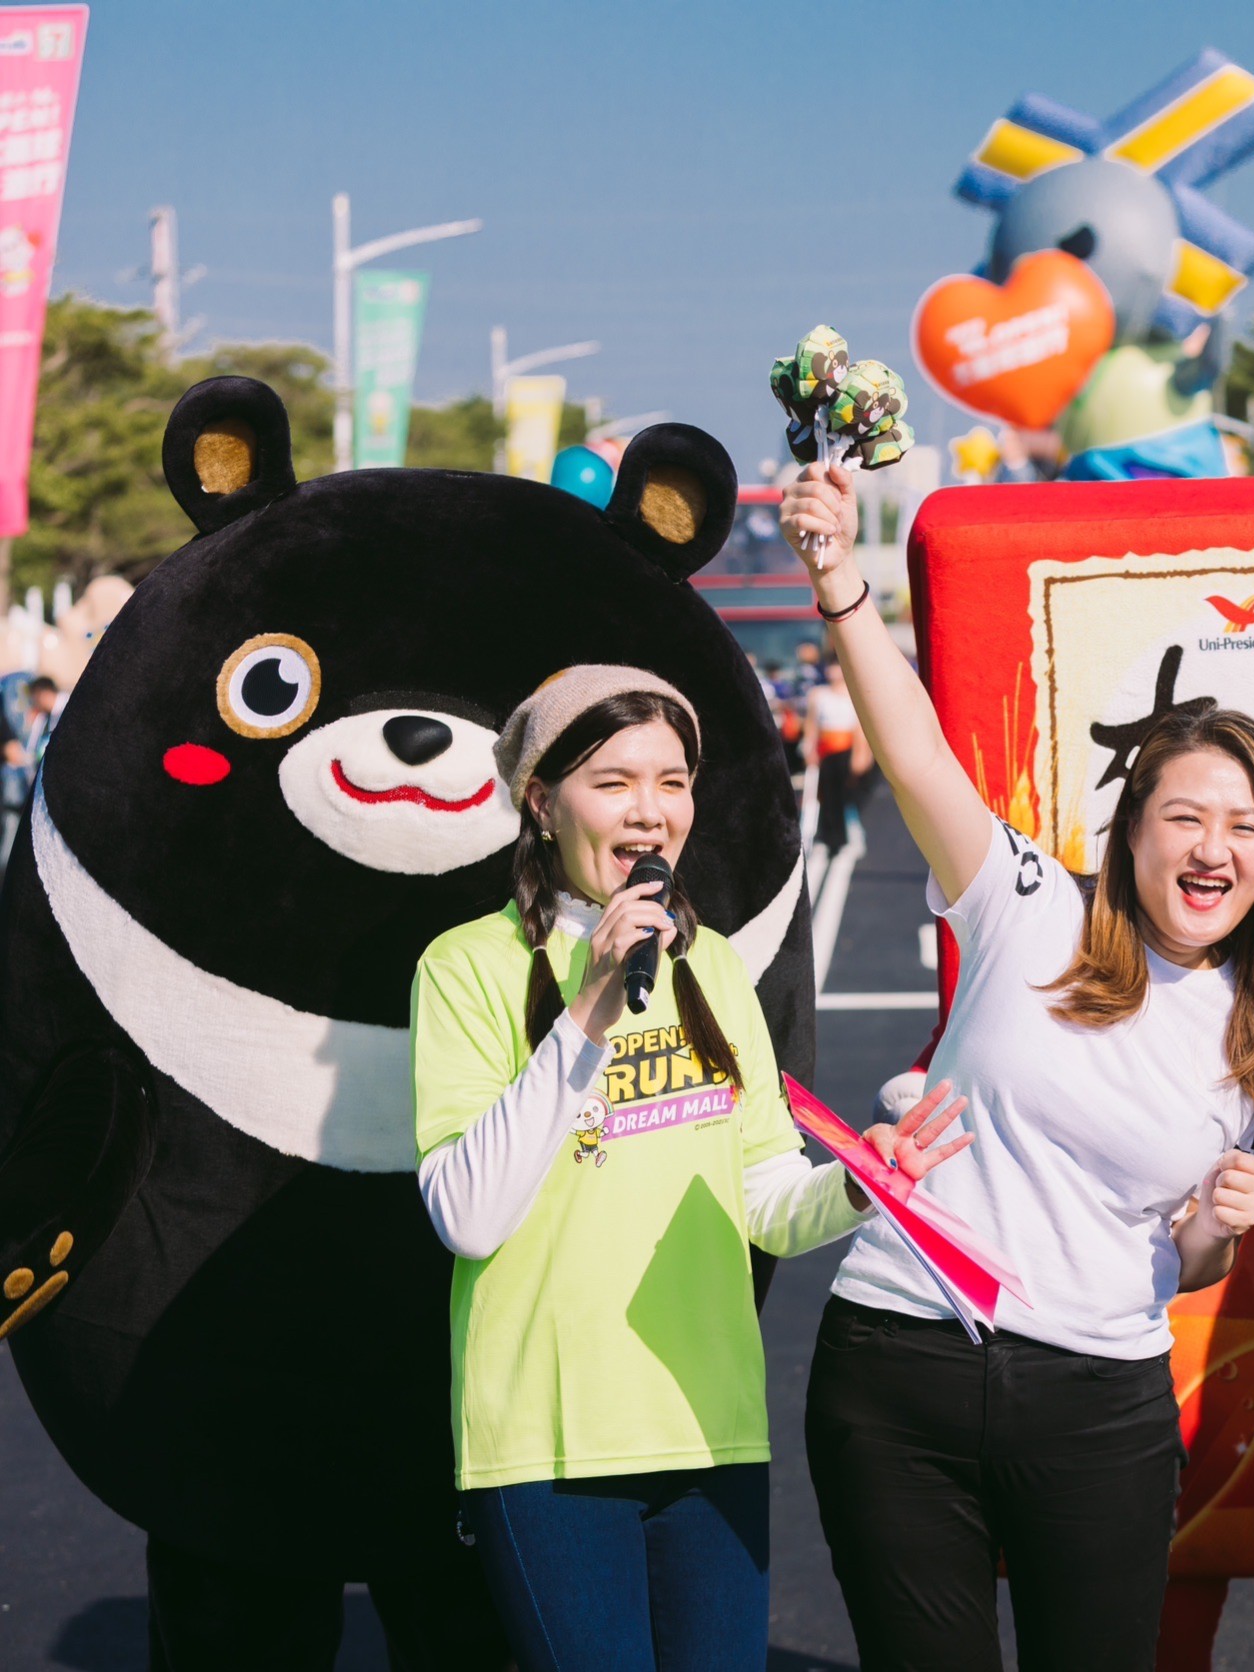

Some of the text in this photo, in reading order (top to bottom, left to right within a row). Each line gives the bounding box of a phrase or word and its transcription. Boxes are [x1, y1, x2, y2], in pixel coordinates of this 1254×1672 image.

[610, 1025, 687, 1060] OPEN!
[612, 1104, 677, 1134] DREAM
[682, 1093, 728, 1119] MALL
